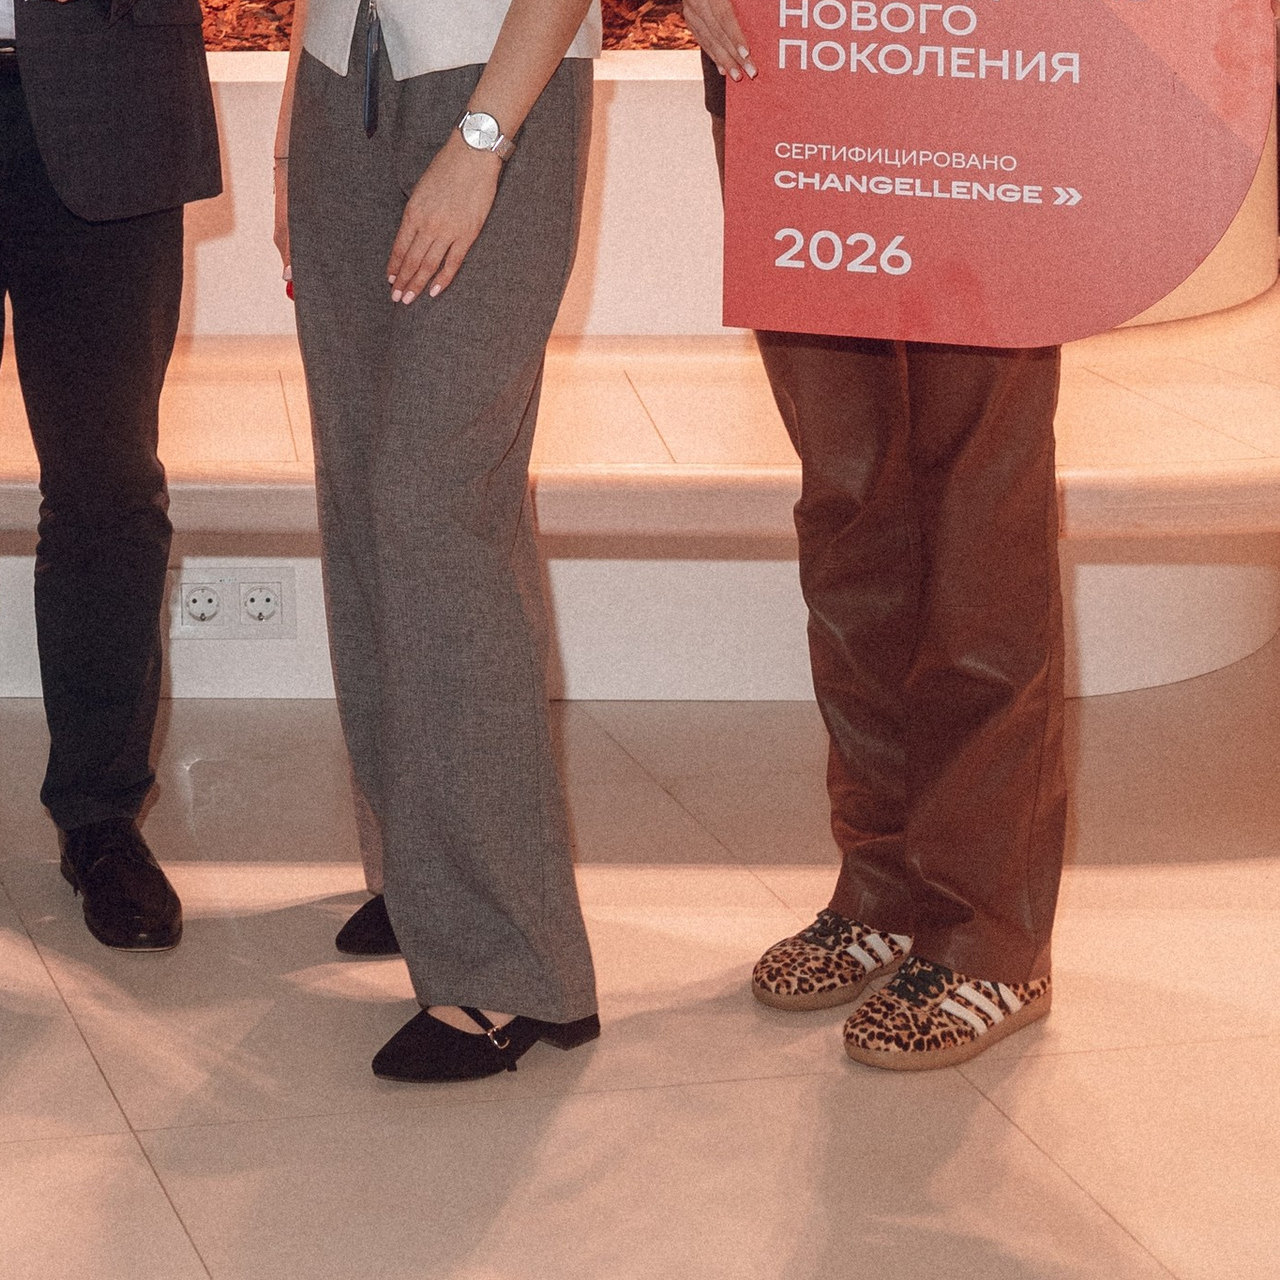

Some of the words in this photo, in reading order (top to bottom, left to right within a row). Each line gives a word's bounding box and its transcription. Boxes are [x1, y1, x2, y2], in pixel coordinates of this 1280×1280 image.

[777, 39, 1081, 84] ПОКОЛЕНИЯ
[775, 141, 1017, 171] СЕРТИФИЦИРОВАНО
[774, 170, 1042, 205] CHANGELLENGE
[774, 228, 912, 275] 2026
